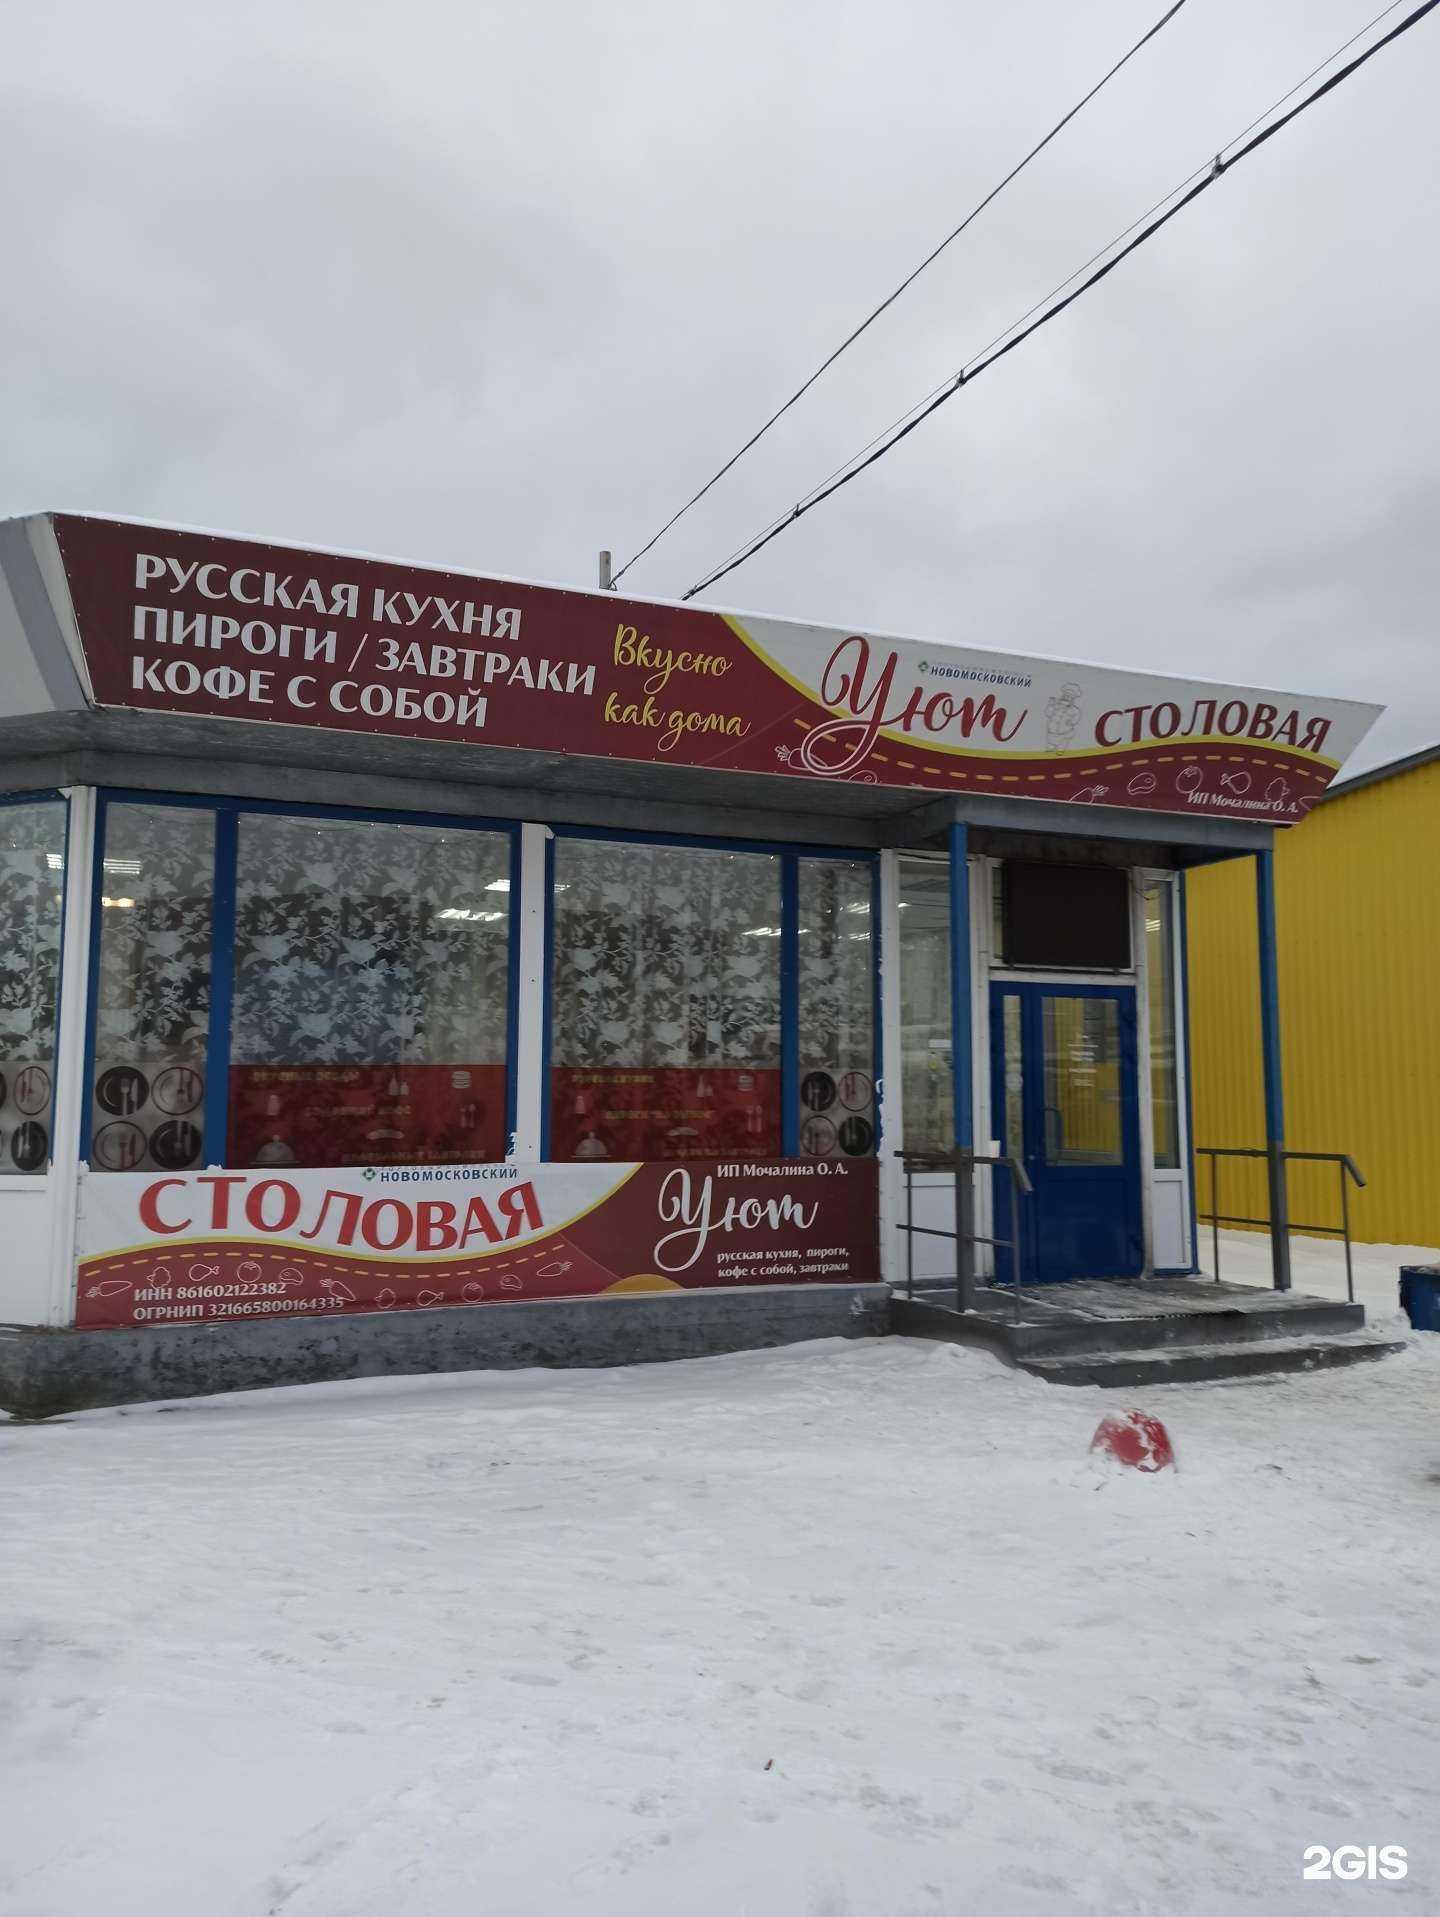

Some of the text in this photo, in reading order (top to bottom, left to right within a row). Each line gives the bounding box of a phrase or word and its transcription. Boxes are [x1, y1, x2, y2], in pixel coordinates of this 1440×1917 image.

[135, 553, 522, 641] РУССКАЯ КУХНЯ
[133, 605, 337, 664] ПИРОГИ
[375, 638, 597, 696] ЗАВТРАКИ
[613, 623, 733, 695] Вкусно
[930, 664, 1032, 689] НОВОМОСКОВСКИЙ
[132, 656, 488, 728] КОФЕ С СОБОЙ
[801, 635, 1028, 776] Уют
[603, 692, 752, 753] как дома
[1094, 700, 1332, 753] СТОЛОВАЯ
[1187, 791, 1209, 805] ИП
[1210, 794, 1272, 810] Мочалина
[380, 1166, 518, 1183] НОВОМОСКОВСКИЙ
[717, 1162, 848, 1178] ИП Мочалина О. А.
[139, 1176, 544, 1252] СТОЛОВАЯ
[653, 1168, 819, 1272] Уют
[717, 1247, 849, 1264] русская кухня, пироги,
[718, 1262, 849, 1280] кофе с собой, завтраки
[132, 1297, 345, 1321] ОГРНИП 321665800164335
[133, 1283, 286, 1302] ИНН 861602122382
